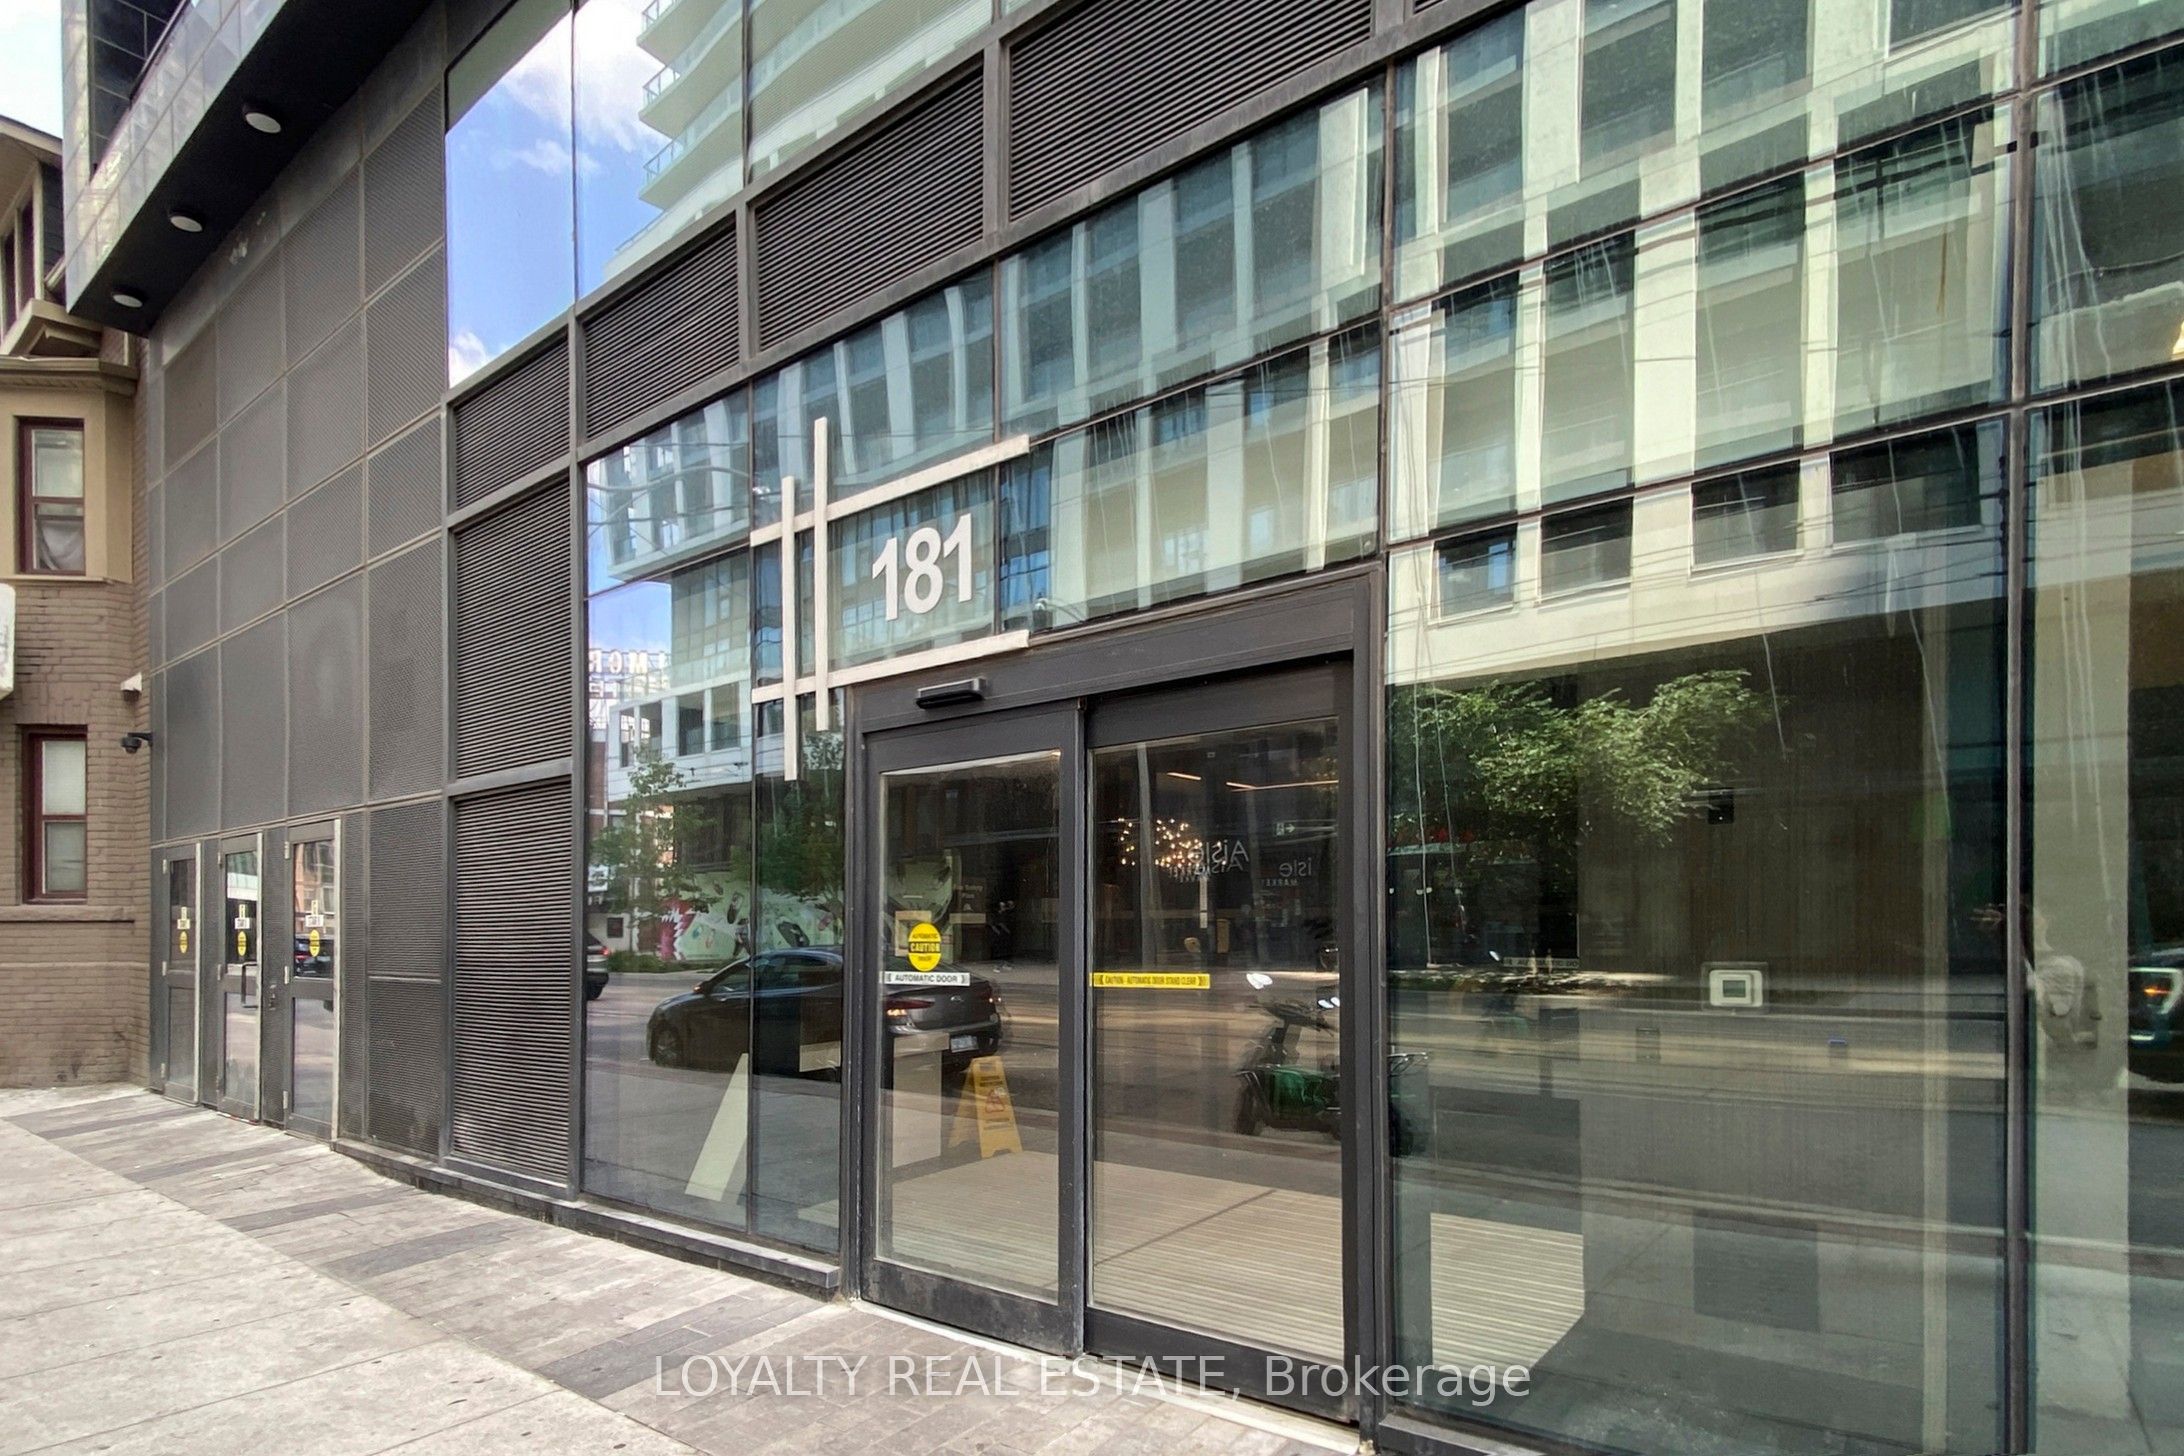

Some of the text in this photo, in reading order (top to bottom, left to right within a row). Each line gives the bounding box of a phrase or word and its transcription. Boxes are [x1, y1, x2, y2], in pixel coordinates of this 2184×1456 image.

[872, 513, 972, 621] 181
[910, 943, 940, 952] CAUTION
[895, 974, 958, 983] AUTOMATIC DOOR
